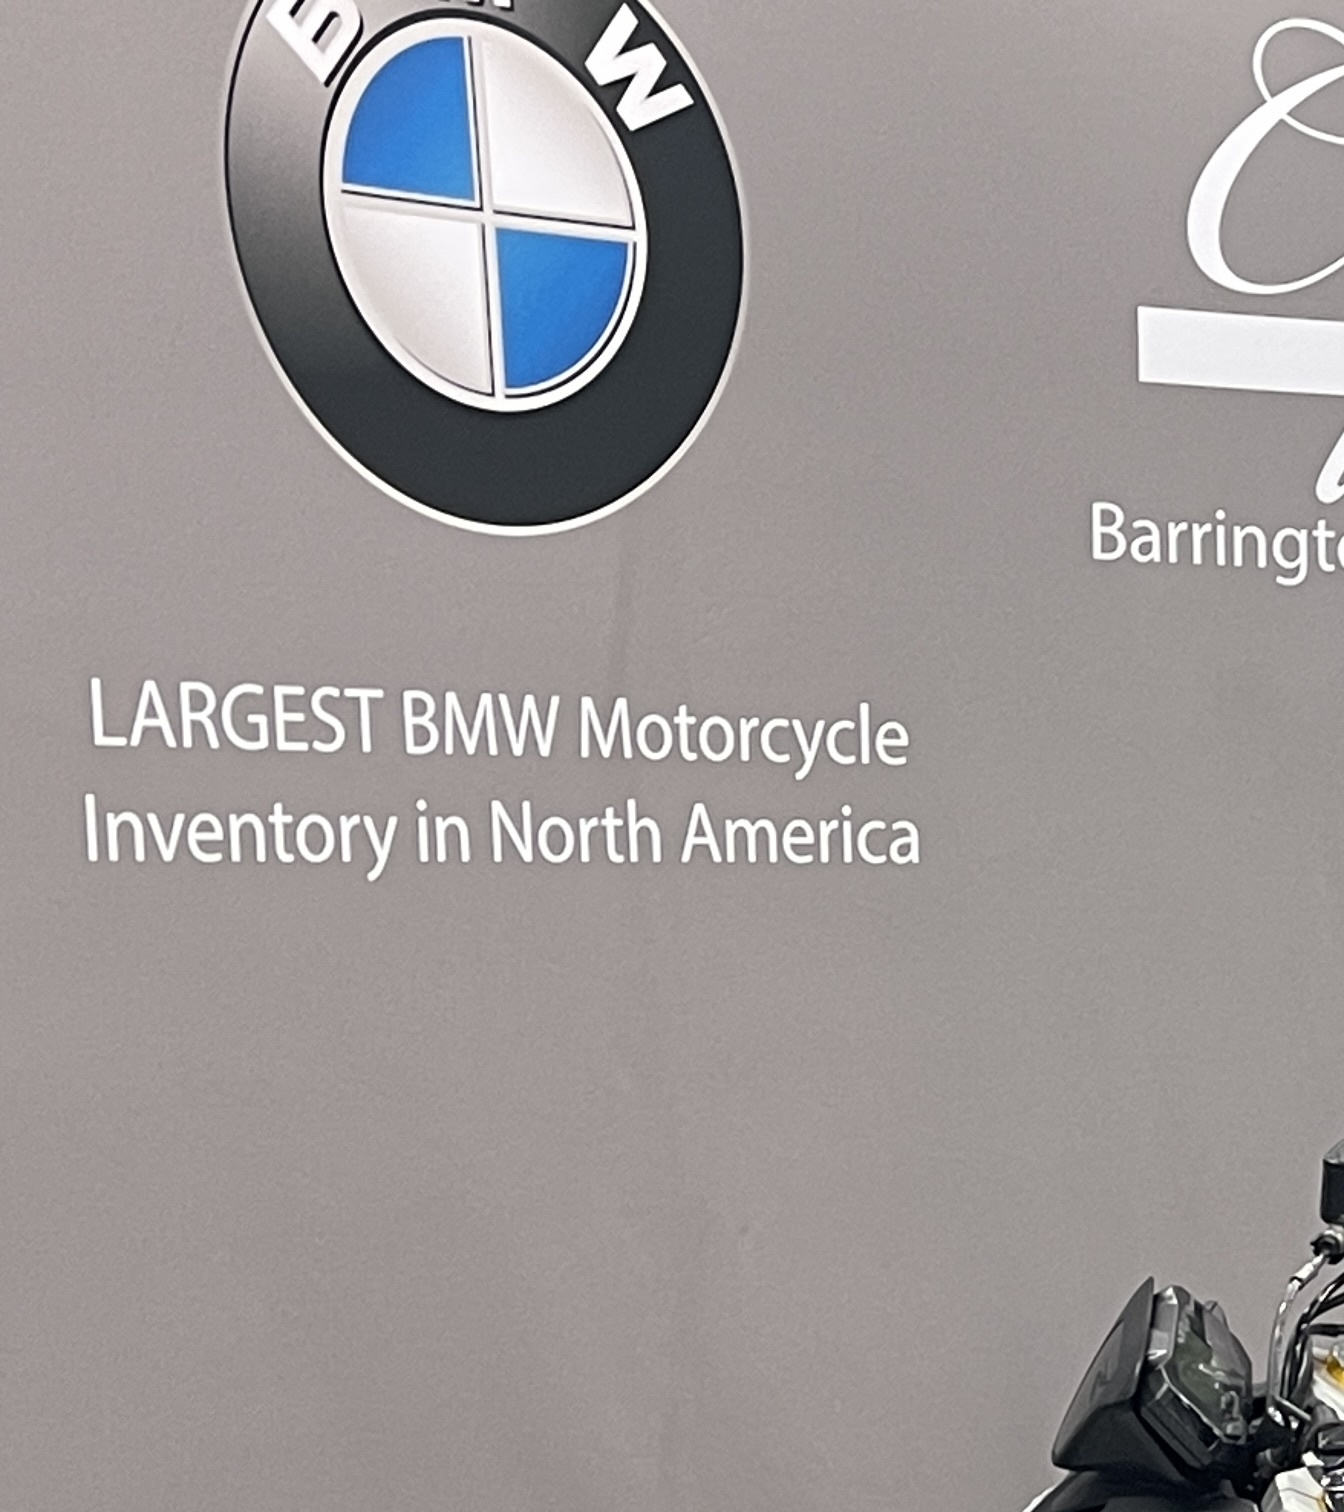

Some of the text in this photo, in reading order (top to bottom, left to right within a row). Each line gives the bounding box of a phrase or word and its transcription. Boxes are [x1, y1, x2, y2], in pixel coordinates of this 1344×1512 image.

[265, 0, 695, 132] BW
[91, 677, 910, 781] LARGEST BMW Motorcycle
[84, 793, 921, 882] Inventory in North America
